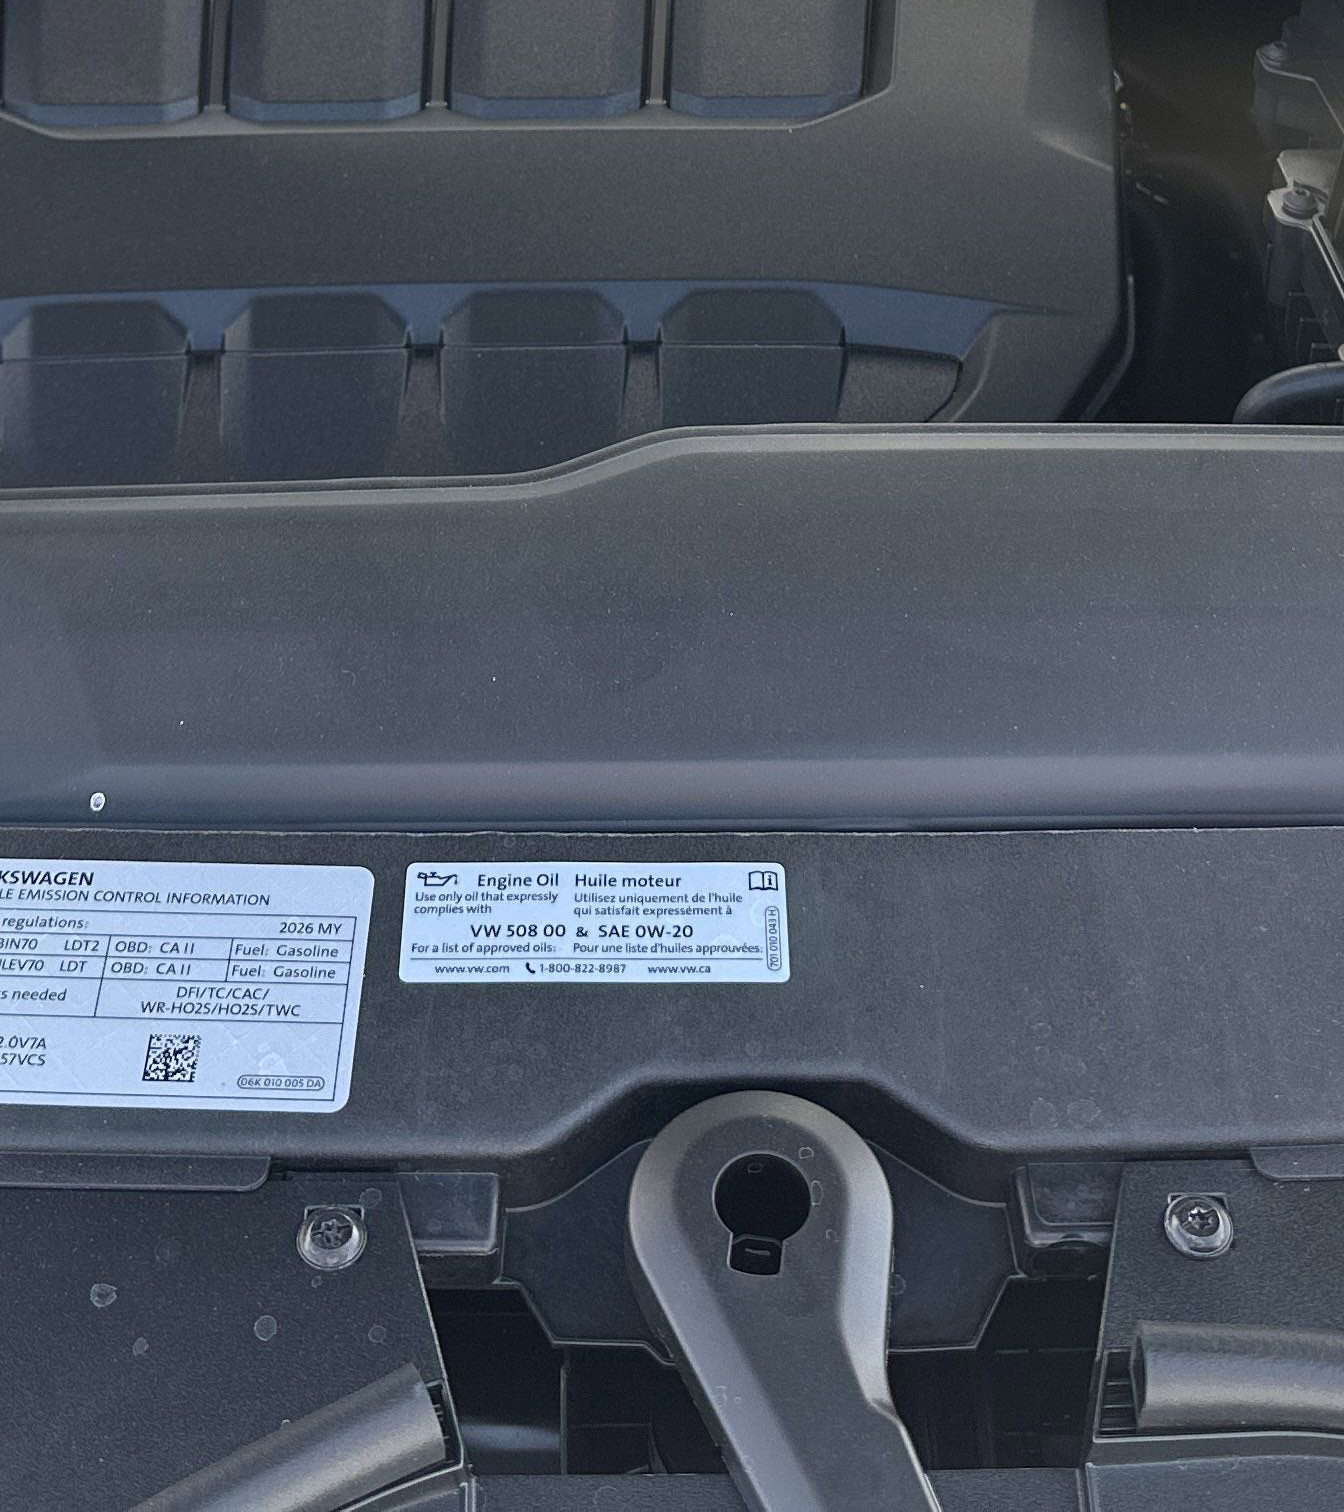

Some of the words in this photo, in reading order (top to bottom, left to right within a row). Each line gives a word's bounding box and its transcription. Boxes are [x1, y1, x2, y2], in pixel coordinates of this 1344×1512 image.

[478, 874, 532, 890] Engine
[537, 874, 558, 887] Oil
[575, 874, 617, 887] Huile
[622, 876, 682, 887] moteur
[18, 889, 89, 901] EMISSION
[94, 891, 161, 903] CONTROL
[167, 893, 270, 906] INFORMATION
[415, 892, 436, 901] Use
[438, 892, 462, 904] only
[465, 892, 478, 901] oil
[481, 892, 504, 901] that
[507, 891, 558, 903] expressly
[574, 893, 616, 903] Utilisez
[619, 894, 689, 906] uniquement
[692, 893, 705, 903] de
[414, 904, 463, 916] complies
[467, 905, 492, 913] with
[574, 906, 592, 918] qui
[595, 905, 640, 915] satisfait
[642, 906, 719, 918] expressément
[726, 906, 732, 915] à
[2, 916, 89, 930] regulations:
[279, 922, 313, 933] 2026
[318, 923, 342, 935] MY
[471, 924, 501, 937] VW
[507, 924, 537, 937] 508
[544, 924, 566, 937] 00
[576, 927, 589, 938] &
[598, 925, 630, 938] SAE
[636, 925, 693, 938] 0W-20
[64, 939, 100, 951] LDT2
[115, 941, 153, 953] OBD:
[235, 944, 268, 956] Fuel:
[277, 945, 338, 958] Gasoline
[411, 943, 428, 952] For
[442, 943, 457, 952] list
[462, 943, 474, 952] of
[477, 943, 529, 956] approved
[60, 960, 87, 972] LDT
[111, 962, 149, 974] OBD:
[231, 965, 265, 977] Fuel:
[274, 966, 335, 979] Gasoline
[435, 965, 509, 973] www.vw.com
[540, 963, 626, 973] 1-800-822-8987
[648, 965, 711, 974] www.vw.ca
[12, 989, 67, 1001] needed
[176, 987, 269, 999] DFI/TC/CAC/
[241, 1078, 262, 1086] 06K
[264, 1078, 282, 1086] 010
[285, 1079, 304, 1087] 005
